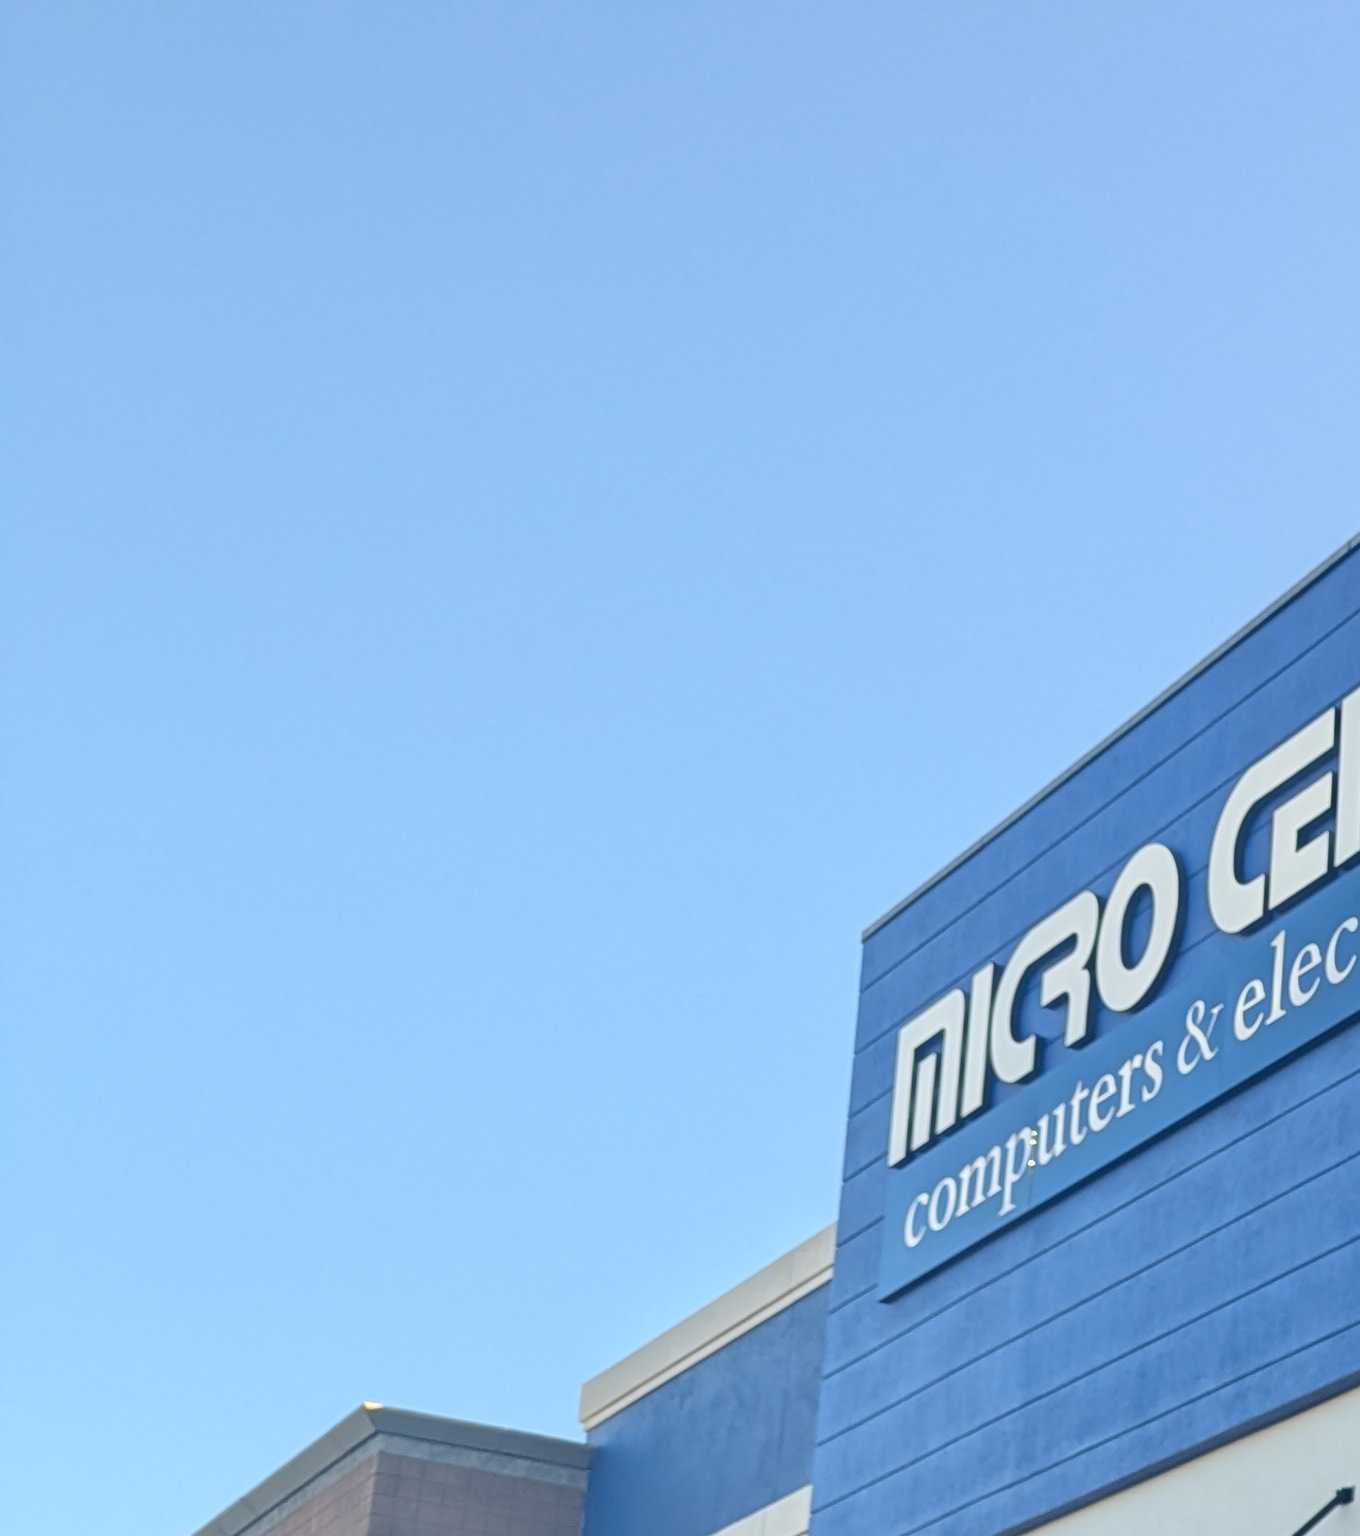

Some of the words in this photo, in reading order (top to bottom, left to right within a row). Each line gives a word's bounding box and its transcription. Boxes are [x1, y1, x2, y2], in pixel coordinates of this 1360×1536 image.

[888, 843, 1186, 1168] MICRO
[902, 1040, 1164, 1250] computers
[1176, 1000, 1220, 1076] &
